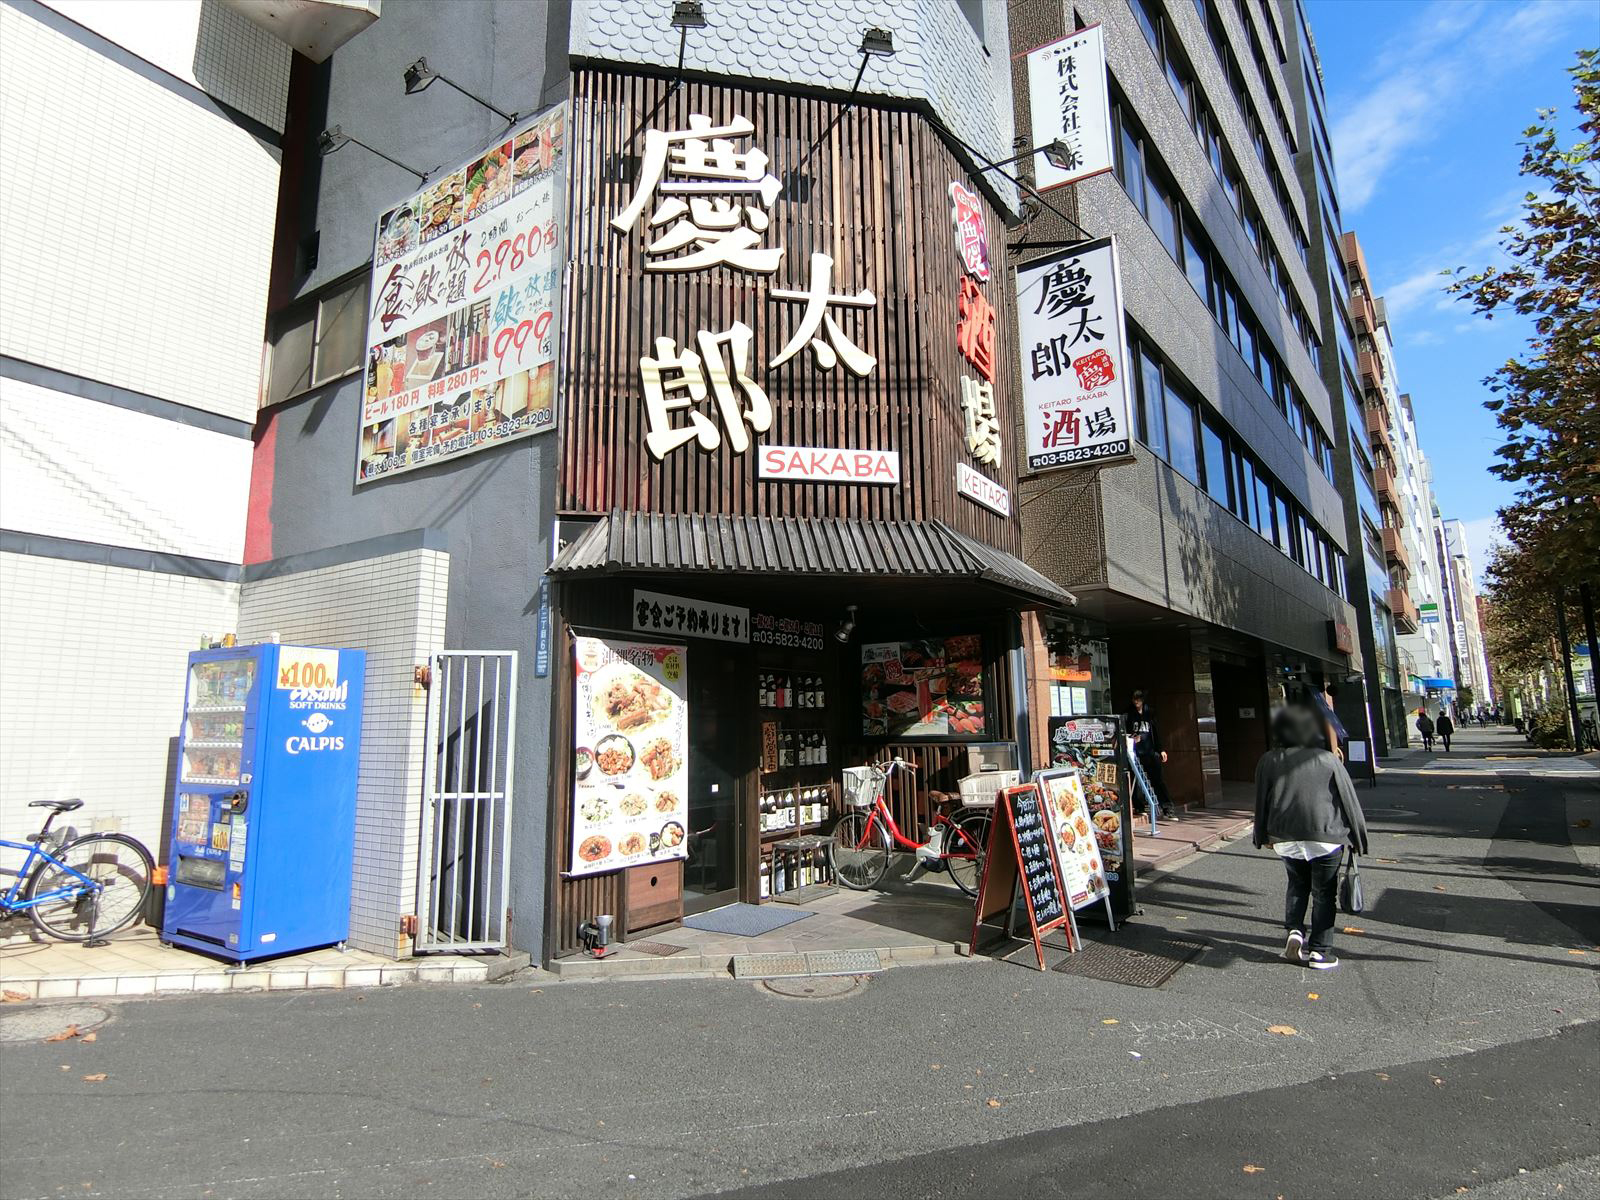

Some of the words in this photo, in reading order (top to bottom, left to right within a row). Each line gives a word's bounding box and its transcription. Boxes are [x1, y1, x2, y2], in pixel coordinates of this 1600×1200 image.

[611, 113, 877, 462] 慶太郎
[1031, 258, 1105, 381] 慶太郎
[956, 275, 1003, 470] 酒場
[365, 402, 389, 420] ビール
[391, 389, 420, 411] 180円
[427, 379, 446, 400] 料理
[408, 395, 494, 435] 各種宴会承ります
[1038, 398, 1072, 410] KEITARO
[1076, 390, 1109, 403] SAKABA
[1042, 407, 1116, 449] 酒場
[765, 449, 895, 479] SAKABA
[1041, 441, 1126, 465] 03-5823-4200
[963, 469, 1008, 512] KEITARO
[288, 701, 313, 710] SOFT
[314, 701, 347, 711] DRINKS
[285, 736, 345, 755] CALPIS
